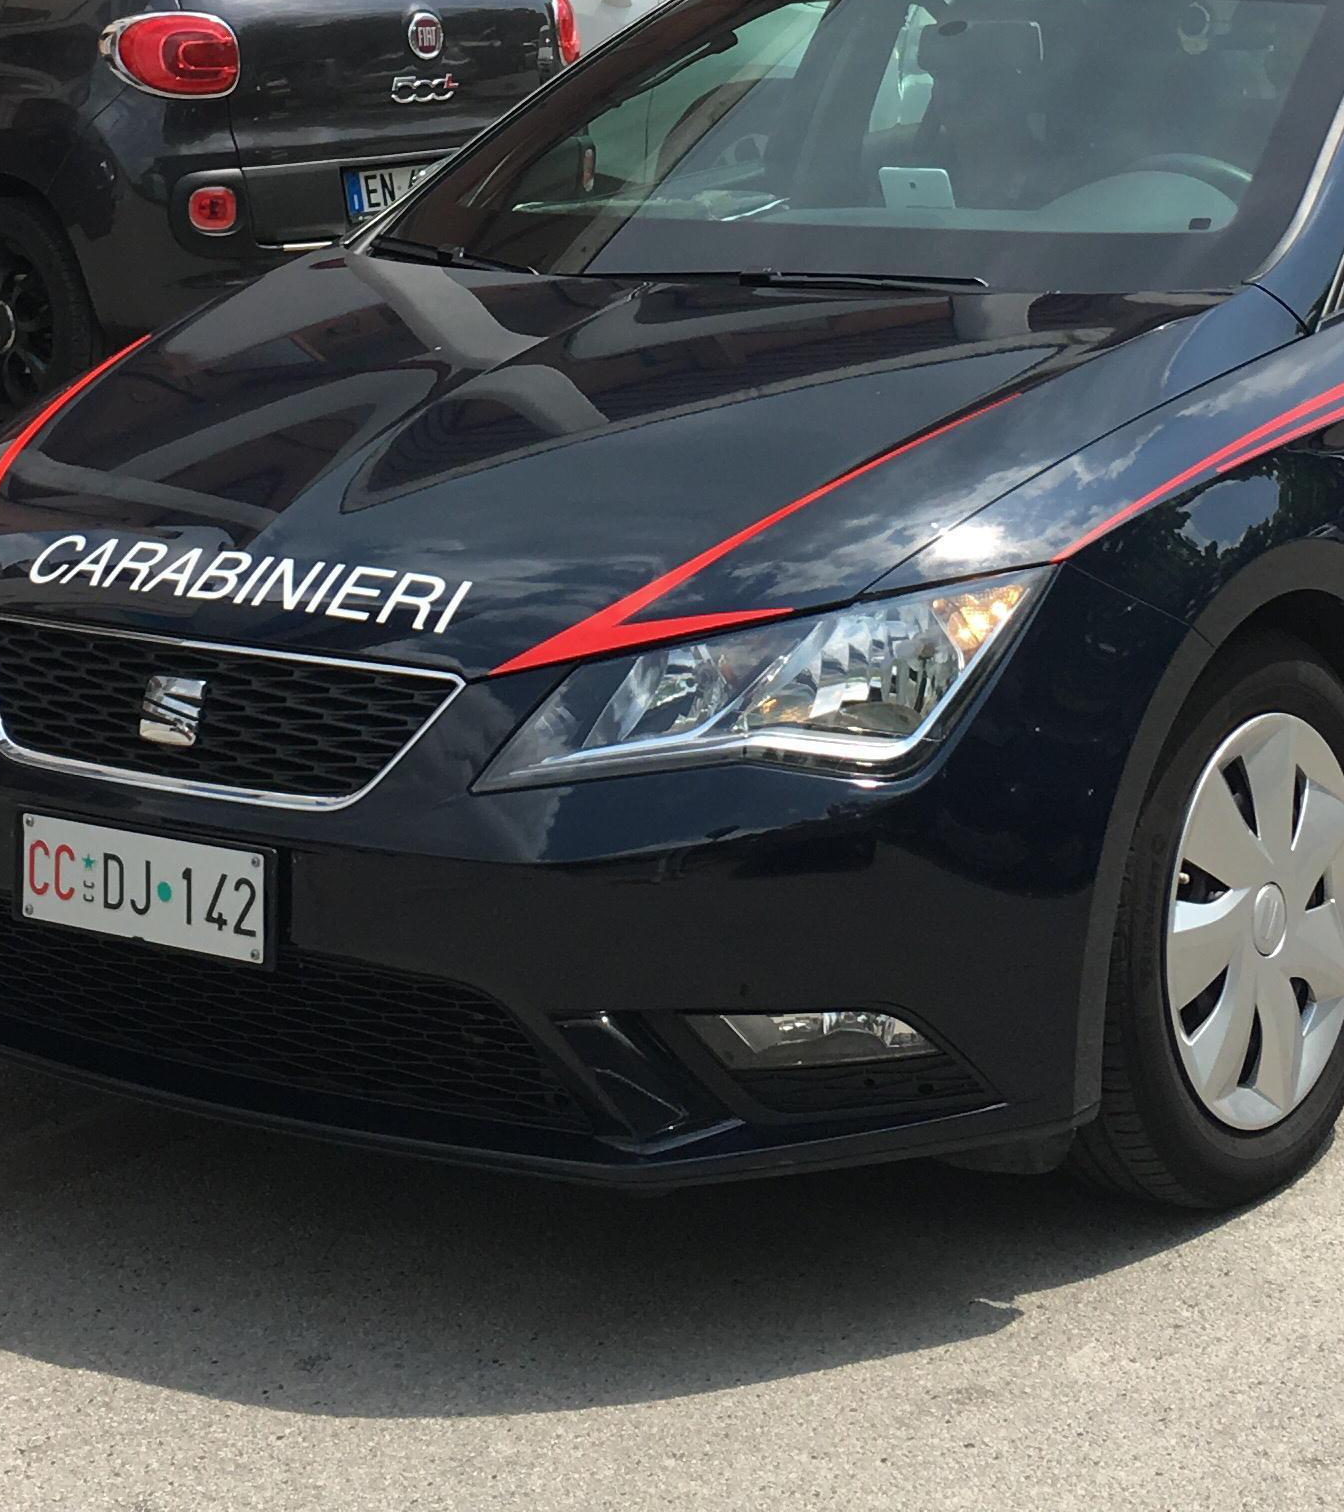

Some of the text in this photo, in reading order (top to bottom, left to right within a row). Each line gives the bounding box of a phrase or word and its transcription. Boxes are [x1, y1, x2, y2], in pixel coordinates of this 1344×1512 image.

[417, 26, 436, 47] FIAT
[363, 172, 396, 208] EN
[29, 535, 473, 634] CARABINIERI
[28, 839, 257, 938] CC DJ 142
